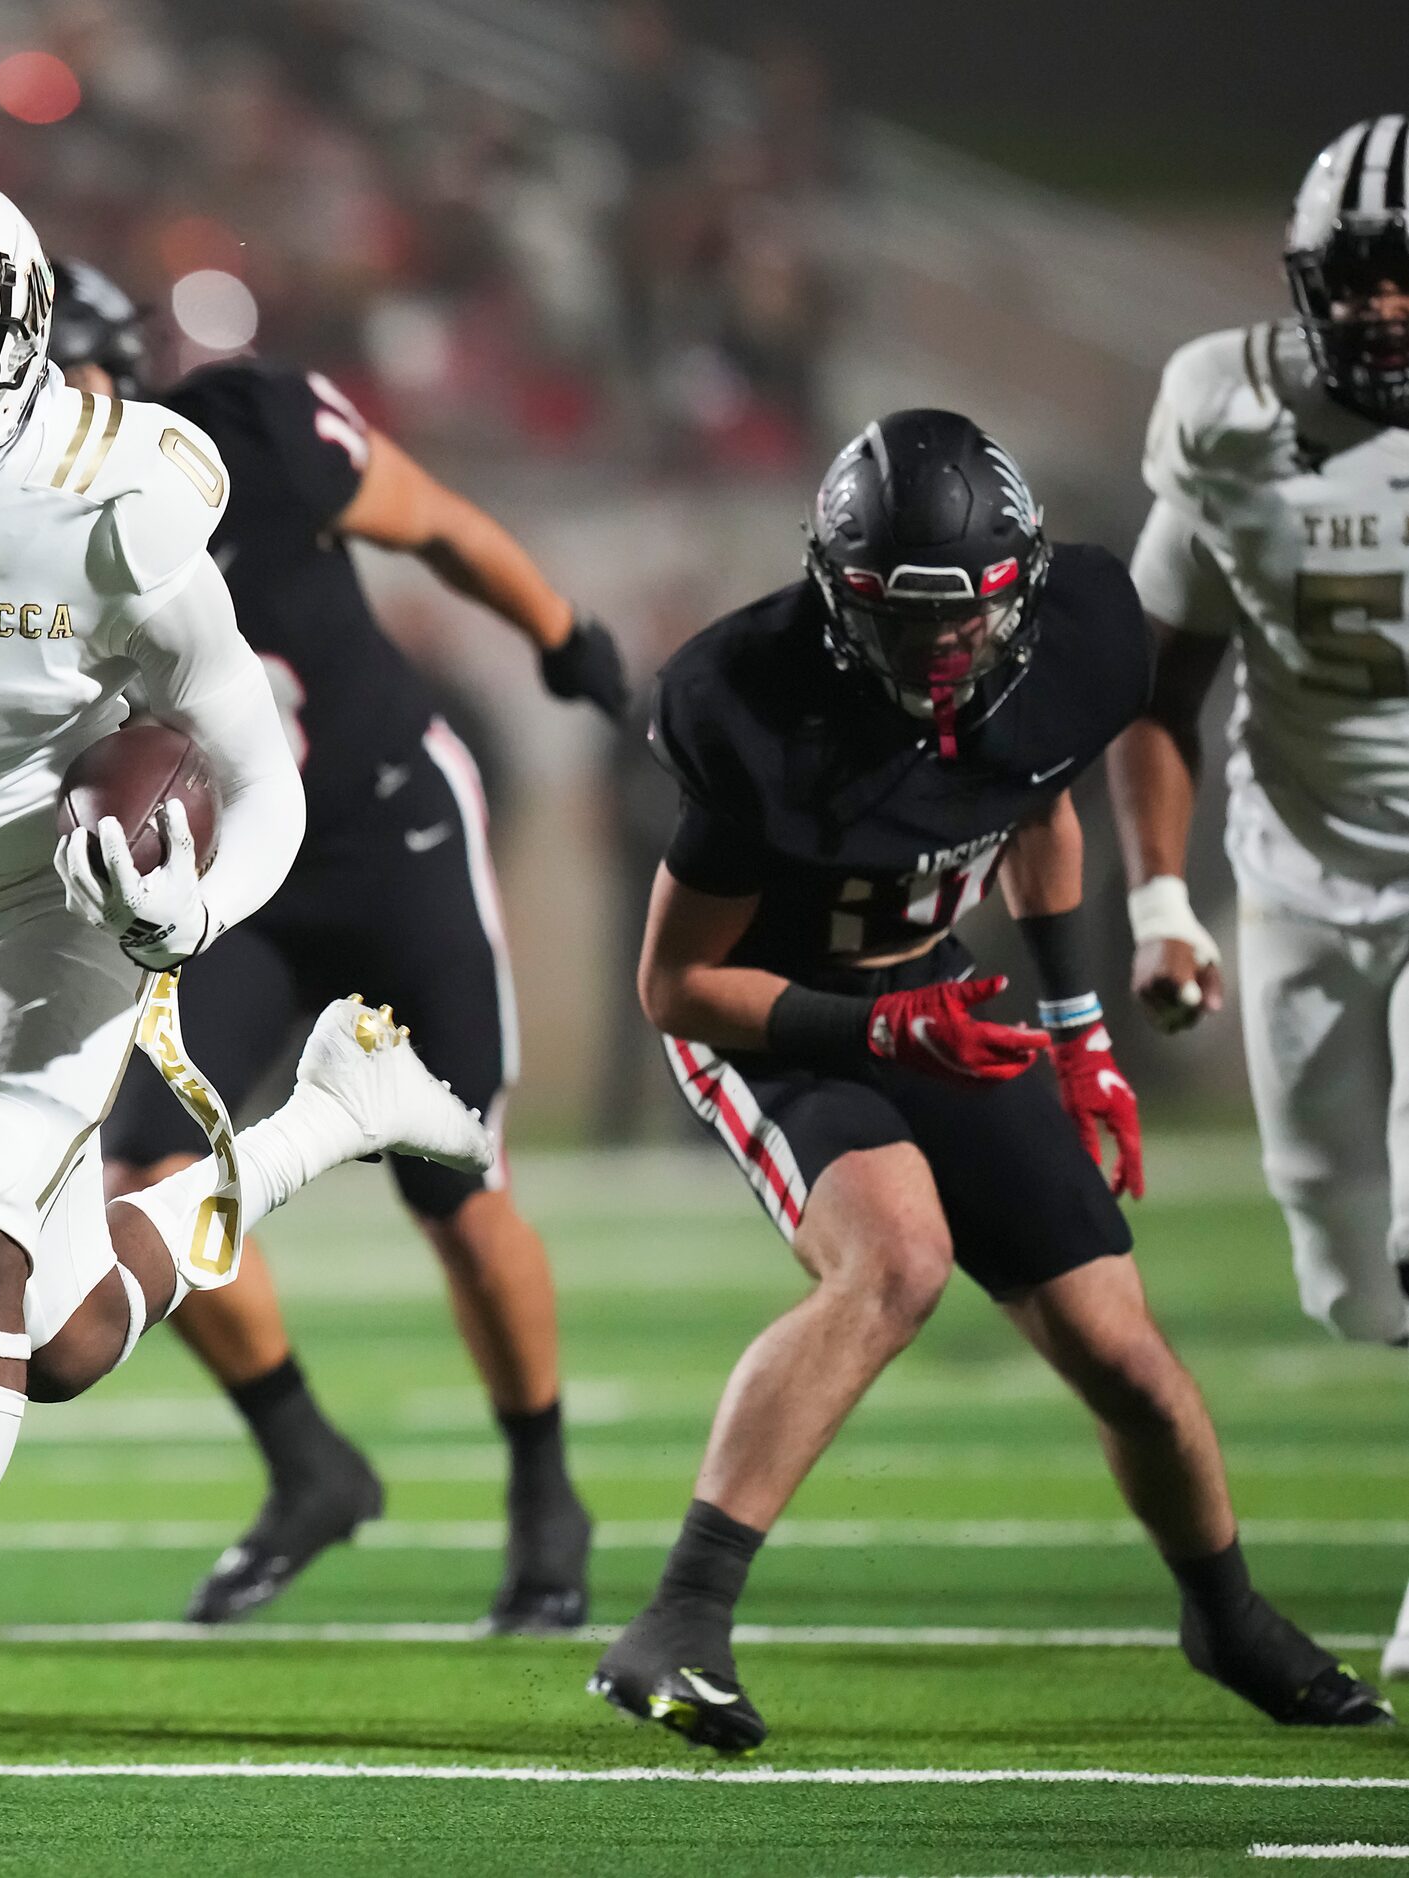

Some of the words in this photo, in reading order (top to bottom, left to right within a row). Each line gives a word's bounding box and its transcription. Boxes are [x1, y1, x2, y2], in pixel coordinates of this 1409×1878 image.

[158, 427, 225, 508] 0
[1303, 514, 1379, 549] THE
[1294, 571, 1409, 700] 5
